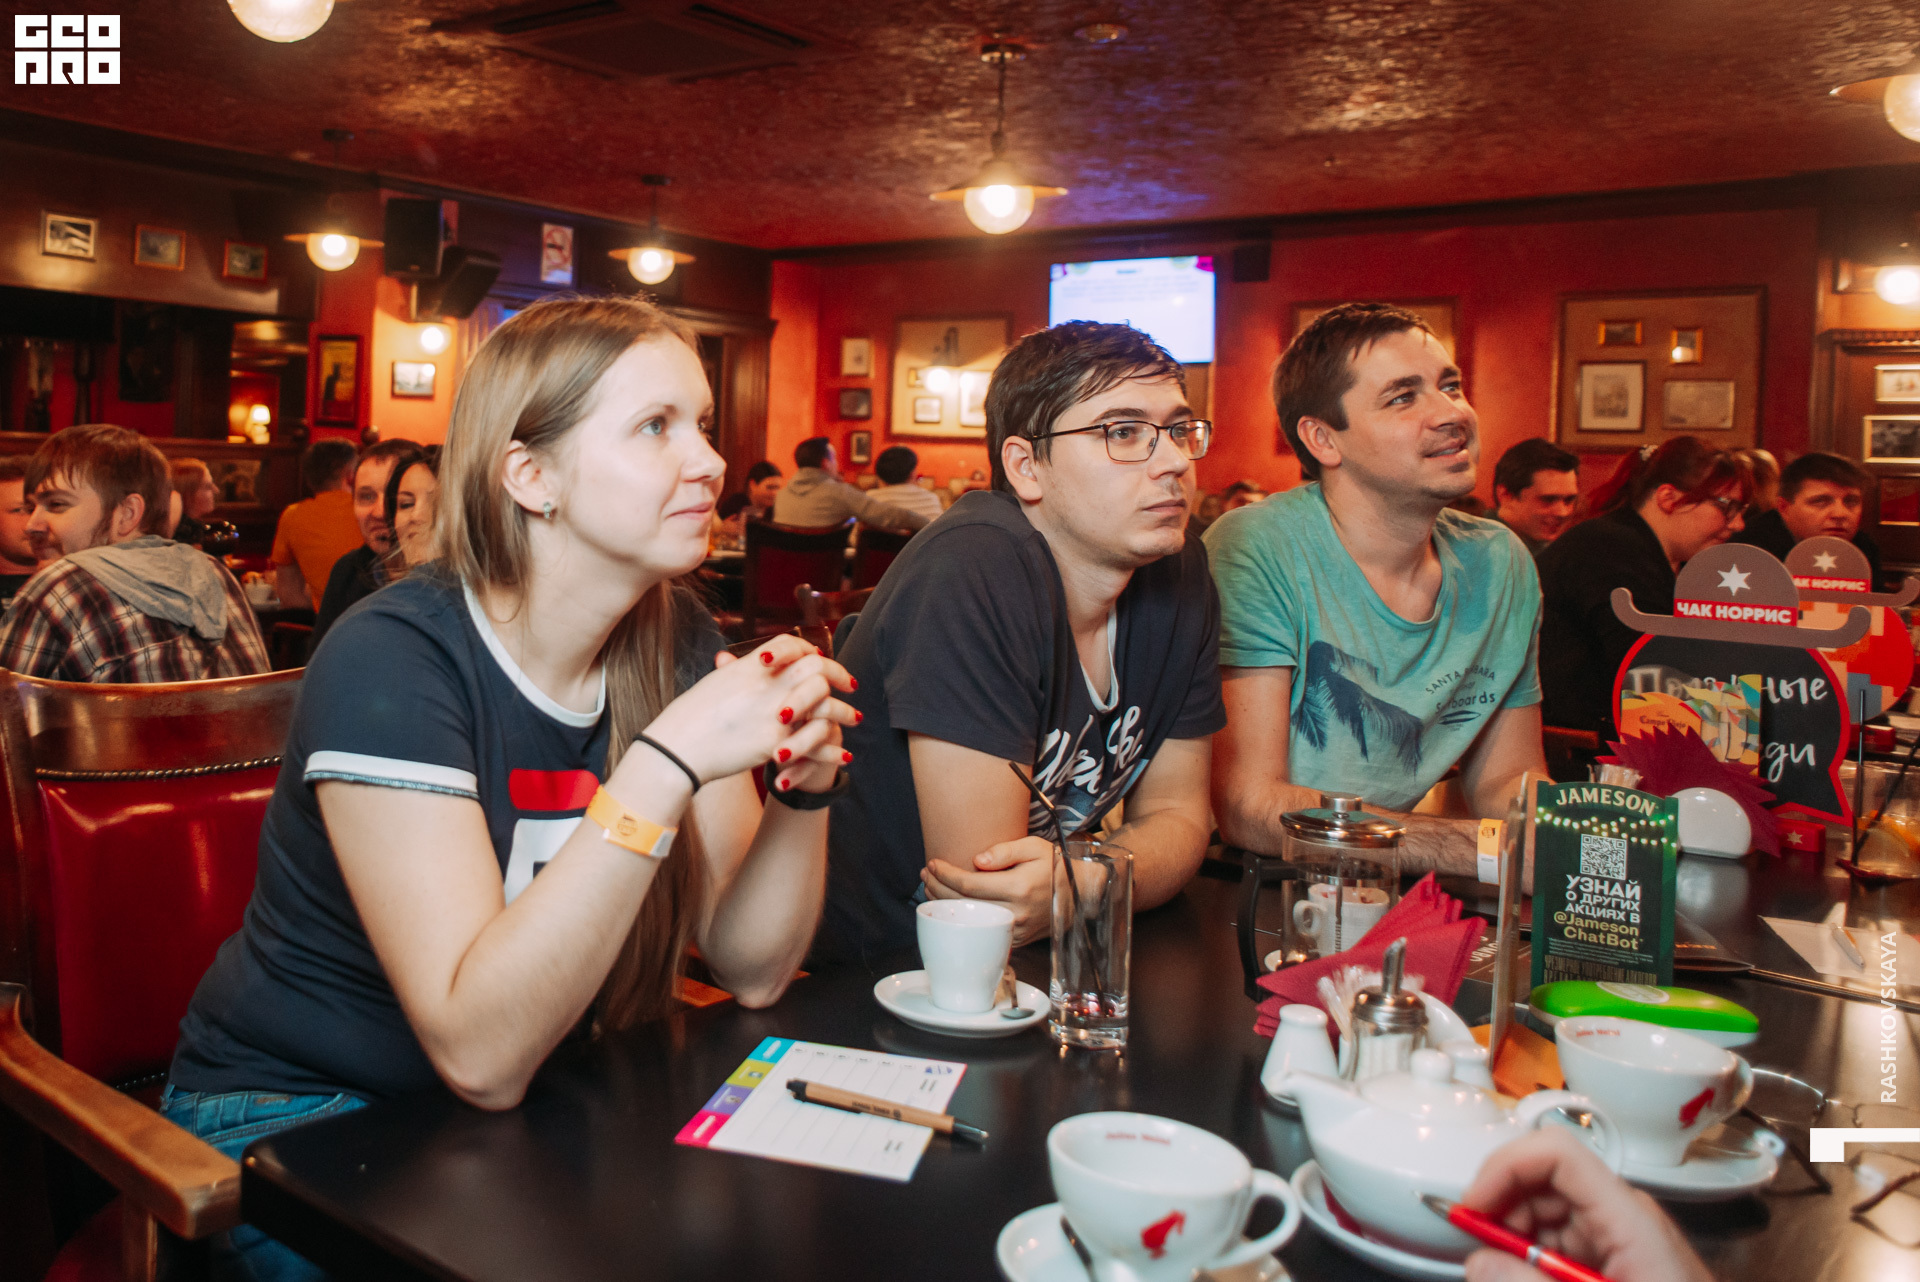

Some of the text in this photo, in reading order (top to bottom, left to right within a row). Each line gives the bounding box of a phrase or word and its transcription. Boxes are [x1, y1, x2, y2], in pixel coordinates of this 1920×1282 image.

[1793, 577, 1866, 592] АК НОРРИС
[1676, 602, 1792, 623] ЧАК НОРРИС
[1425, 670, 1462, 695] SANTA
[1555, 787, 1657, 817] JAMESON
[1565, 874, 1642, 900] УЗНАЙ
[1565, 890, 1641, 912] О ДРУГИХ
[1553, 911, 1640, 937] @Jameson
[1564, 903, 1641, 924] АКЦИЯХ В
